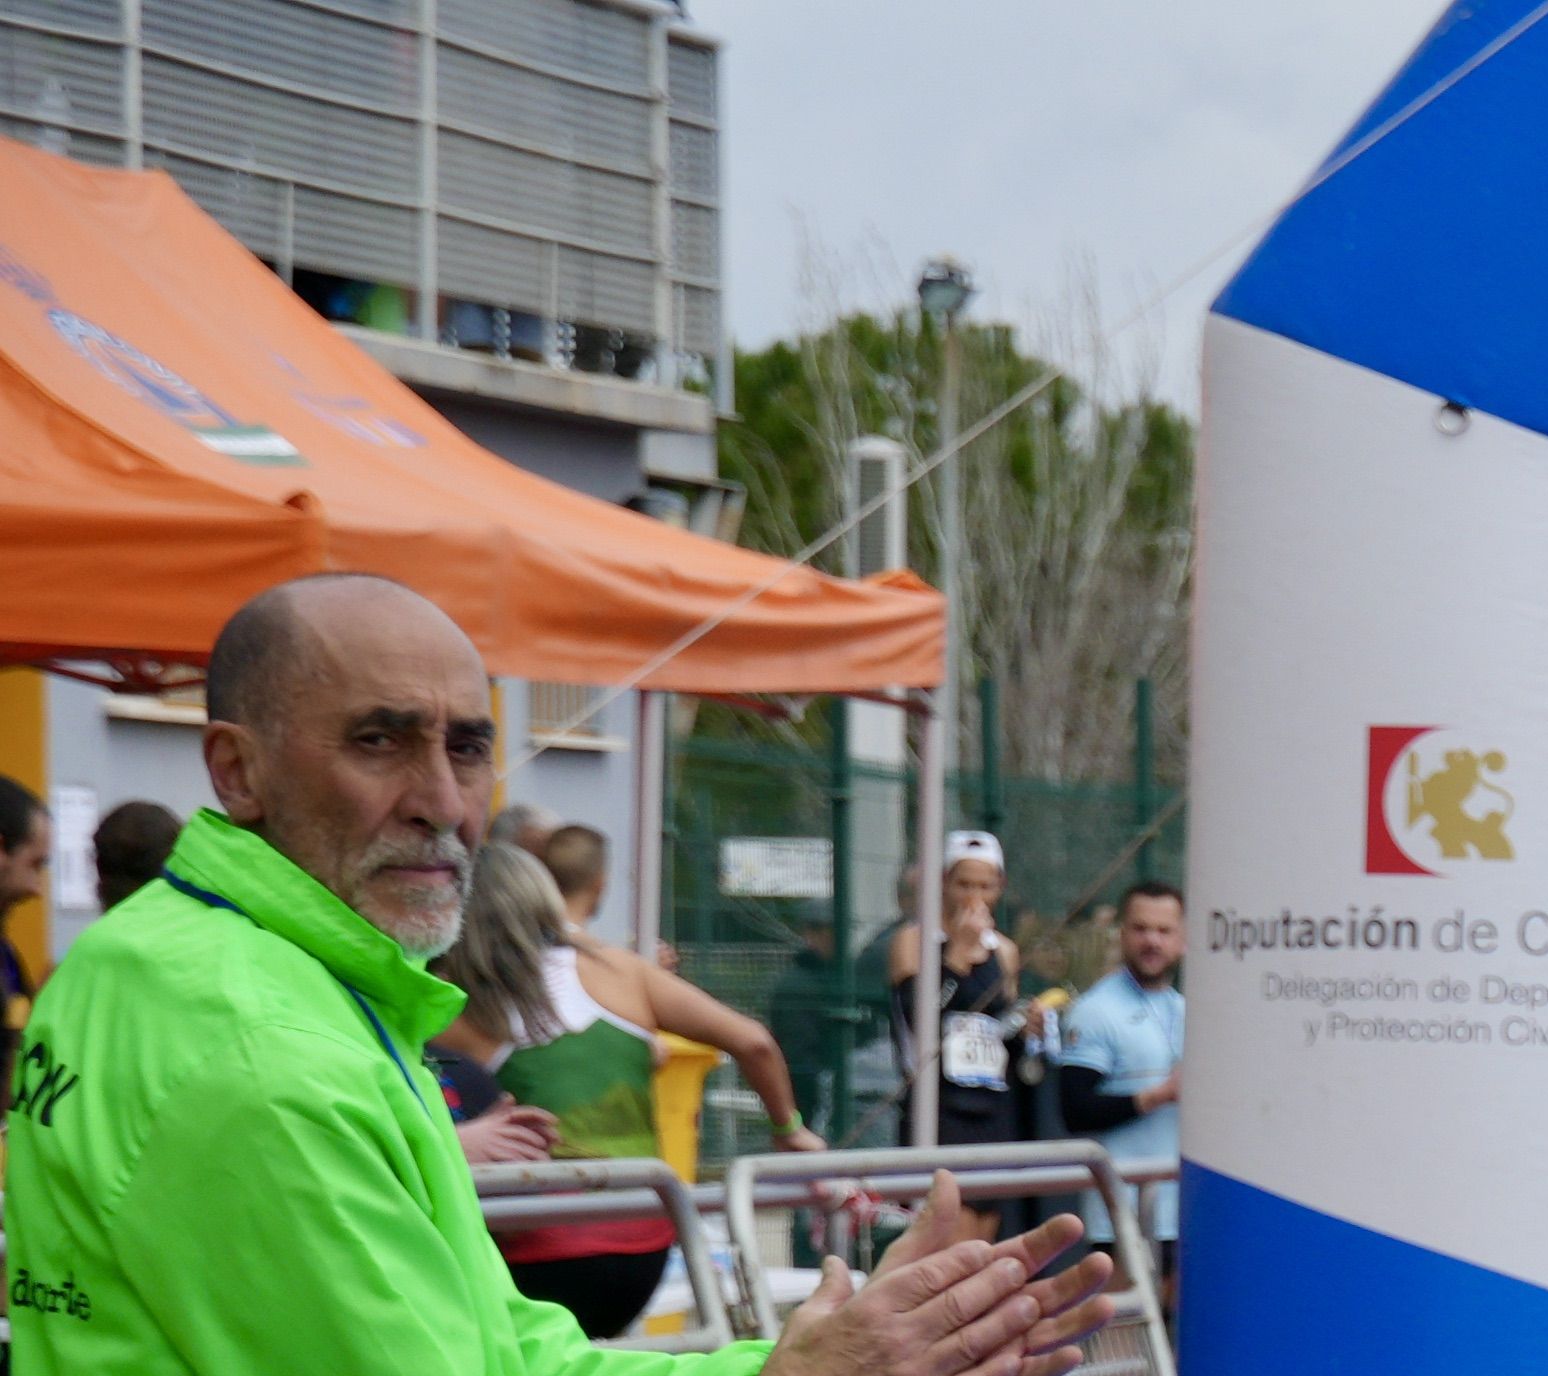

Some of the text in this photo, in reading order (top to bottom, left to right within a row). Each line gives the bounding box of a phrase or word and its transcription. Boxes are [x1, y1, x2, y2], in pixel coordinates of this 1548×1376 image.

[1207, 904, 1420, 960] Diputación
[1431, 908, 1500, 954] de
[1264, 971, 1418, 1006] Delegación
[1431, 976, 1471, 1002] de
[1304, 1019, 1321, 1046] y
[1327, 1012, 1494, 1046] Protección
